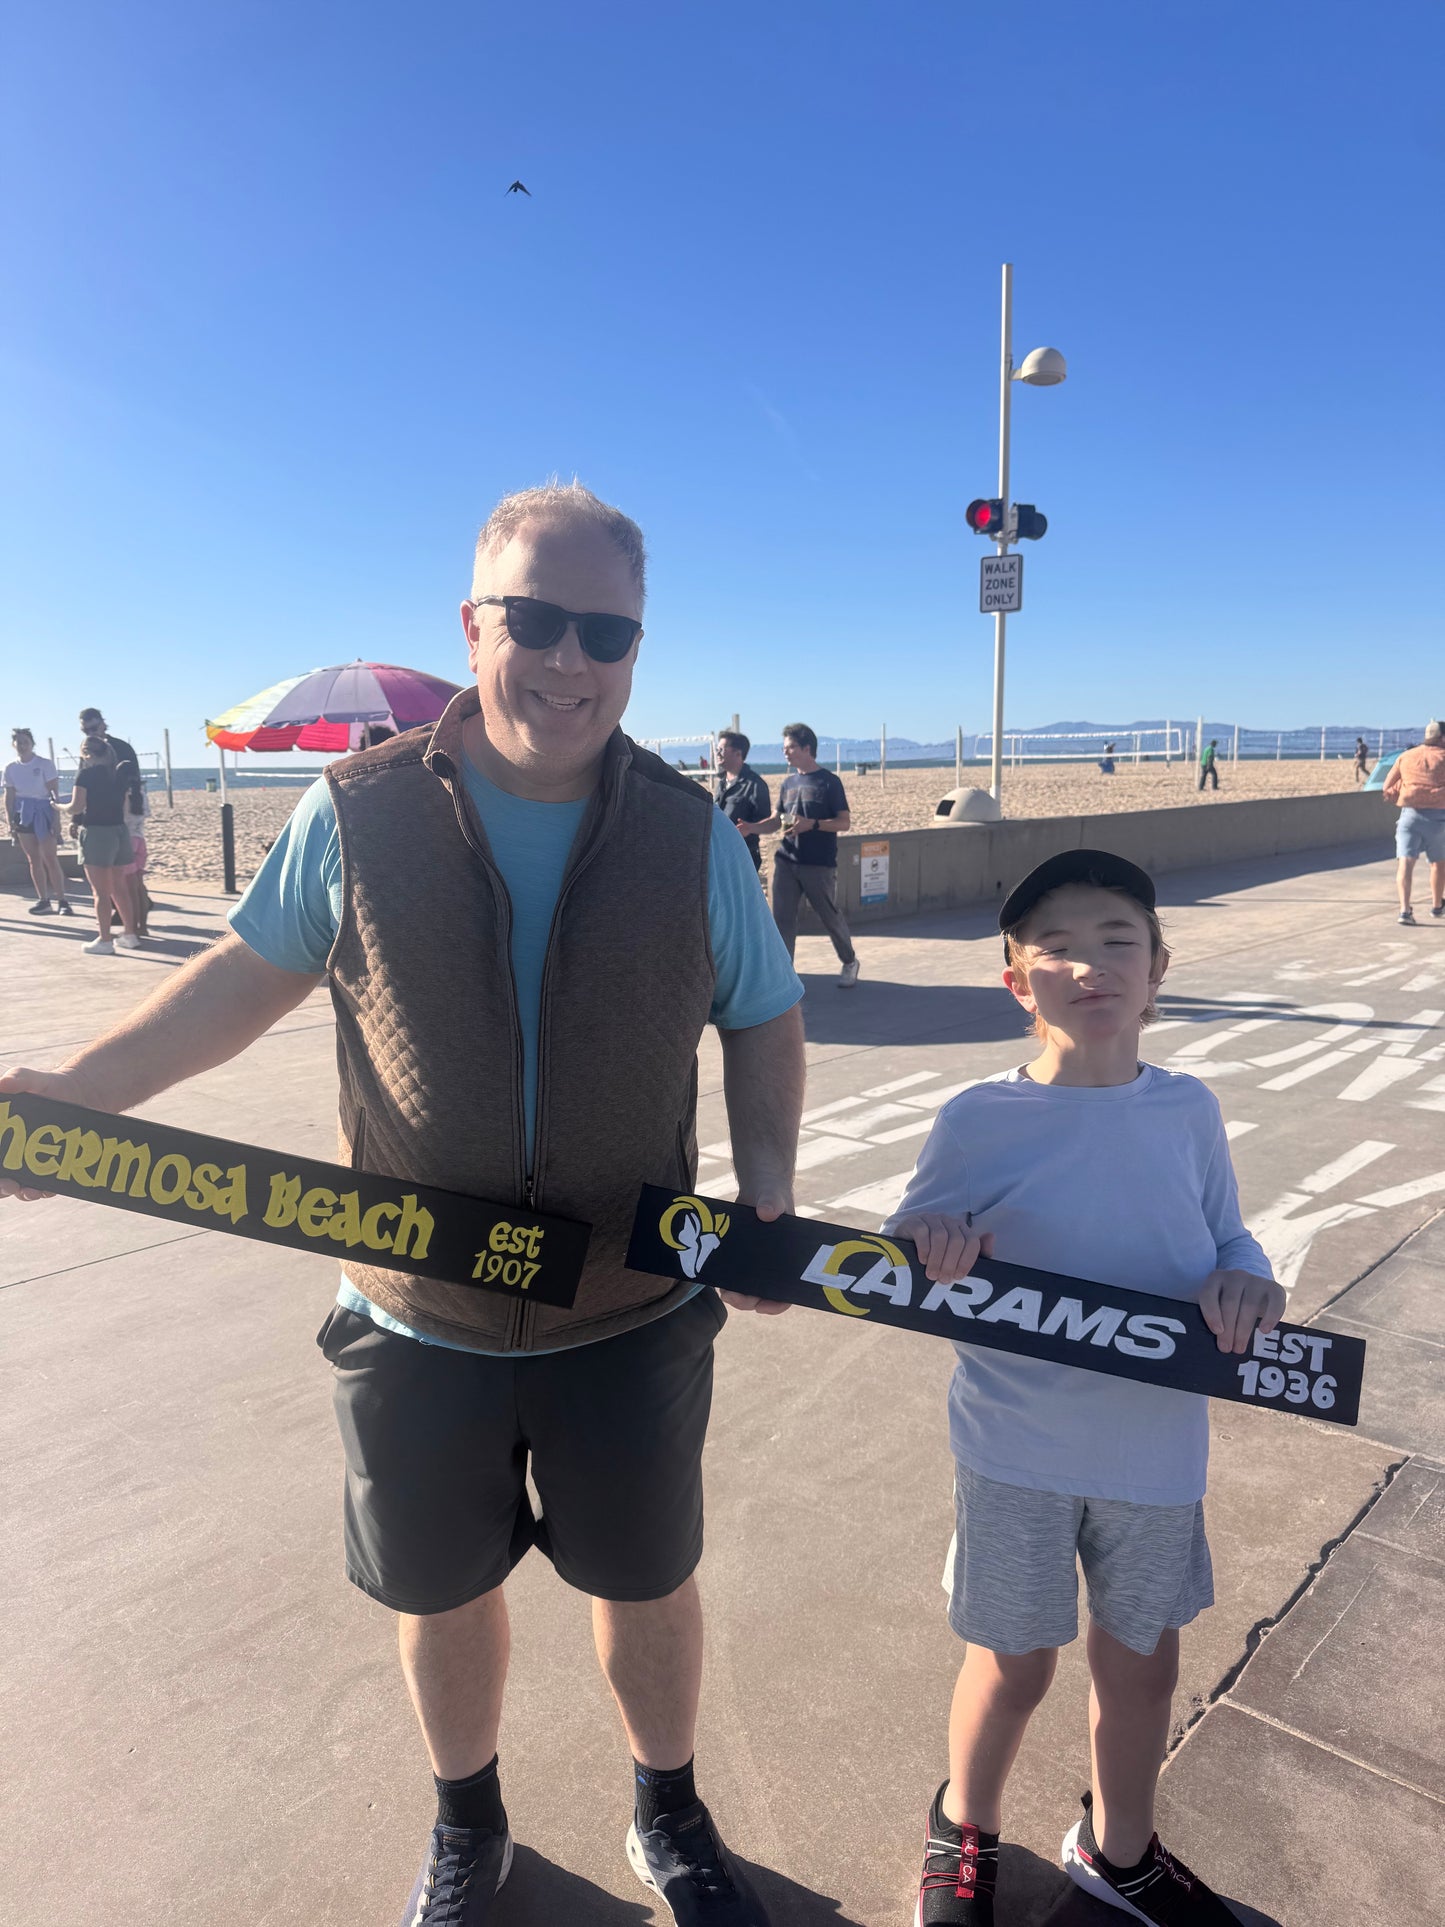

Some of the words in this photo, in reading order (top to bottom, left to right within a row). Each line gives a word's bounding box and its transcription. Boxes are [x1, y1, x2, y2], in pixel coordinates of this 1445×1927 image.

[985, 562, 1016, 574] WALK
[985, 578, 1015, 590] ZONE
[985, 593, 1014, 606] ONLY
[471, 1249, 542, 1290] 1907
[800, 1242, 912, 1307] LA
[920, 1276, 1187, 1360] RAMS
[1252, 1327, 1333, 1373] EST
[1237, 1360, 1338, 1409] 1936
[962, 1834, 975, 1884] NAUTICA
